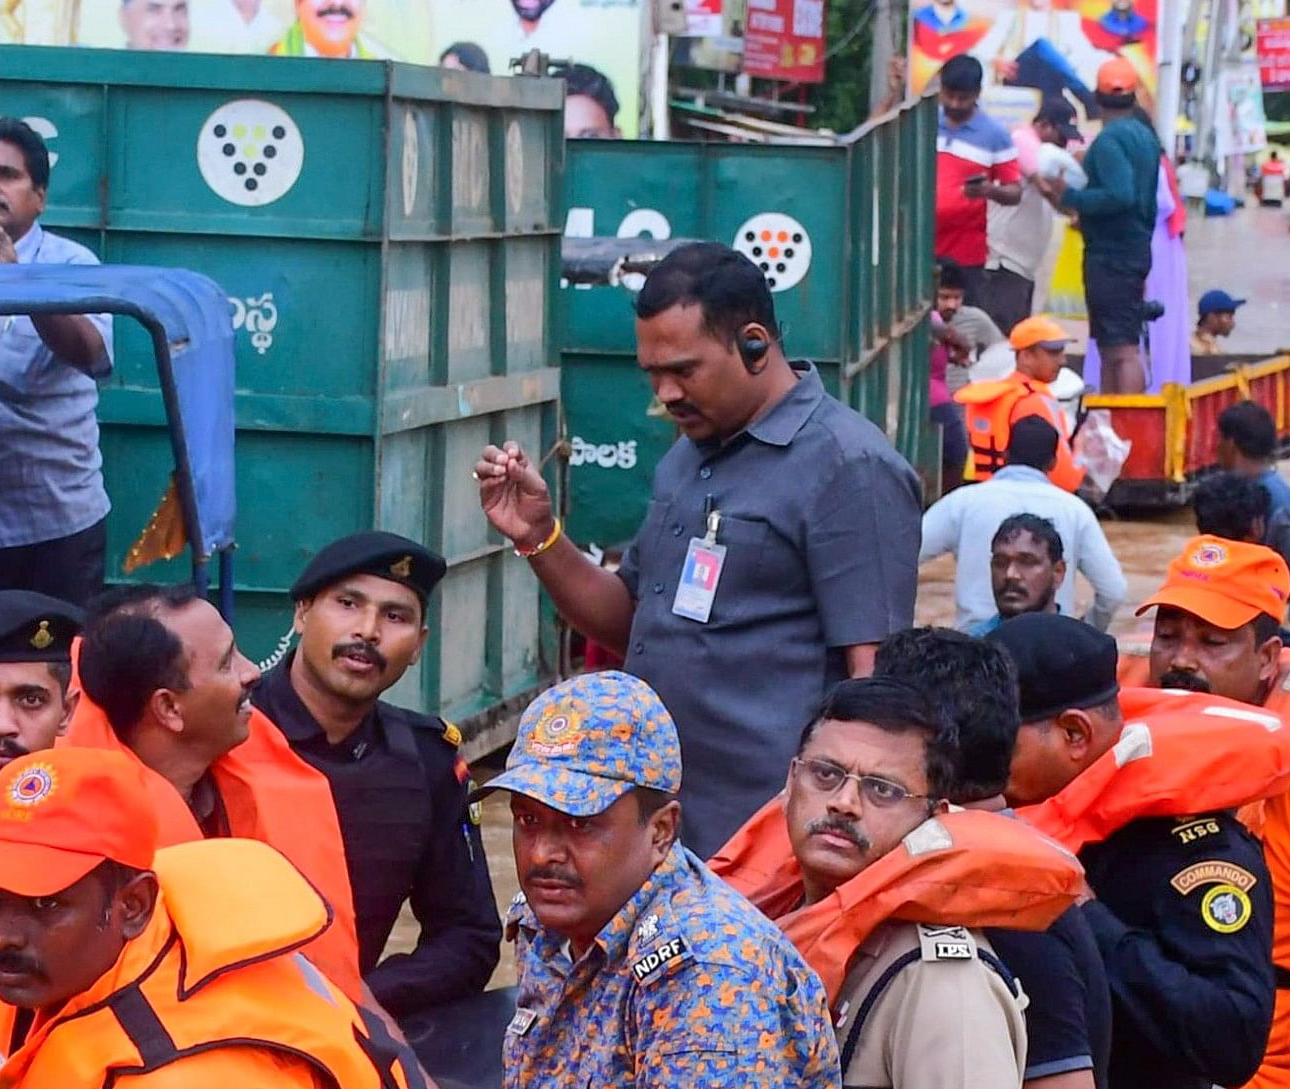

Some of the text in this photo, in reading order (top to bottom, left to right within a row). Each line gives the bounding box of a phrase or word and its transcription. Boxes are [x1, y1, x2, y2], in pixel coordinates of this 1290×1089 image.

[1179, 821, 1220, 844] NSG
[1179, 866, 1249, 888] COMMANDO
[634, 938, 680, 978] NDRF
[937, 943, 972, 958] IPS
